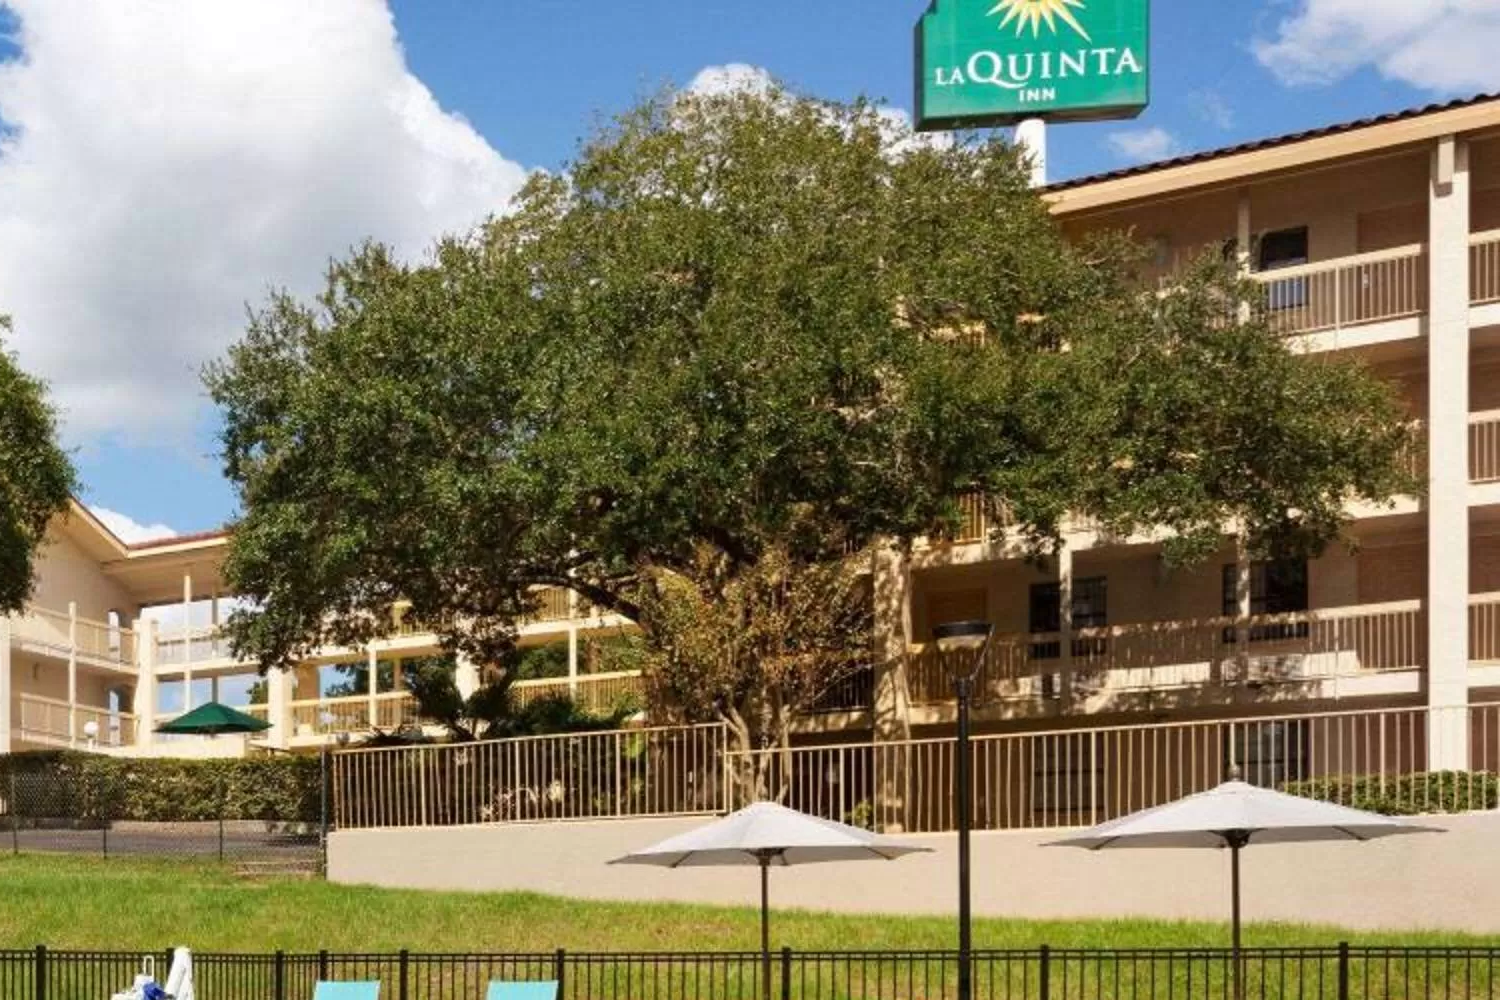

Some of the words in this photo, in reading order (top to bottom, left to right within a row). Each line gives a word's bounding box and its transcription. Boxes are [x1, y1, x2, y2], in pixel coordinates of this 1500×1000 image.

[934, 67, 965, 86] LA
[966, 47, 1143, 89] QUINTA
[1019, 87, 1056, 103] INN
